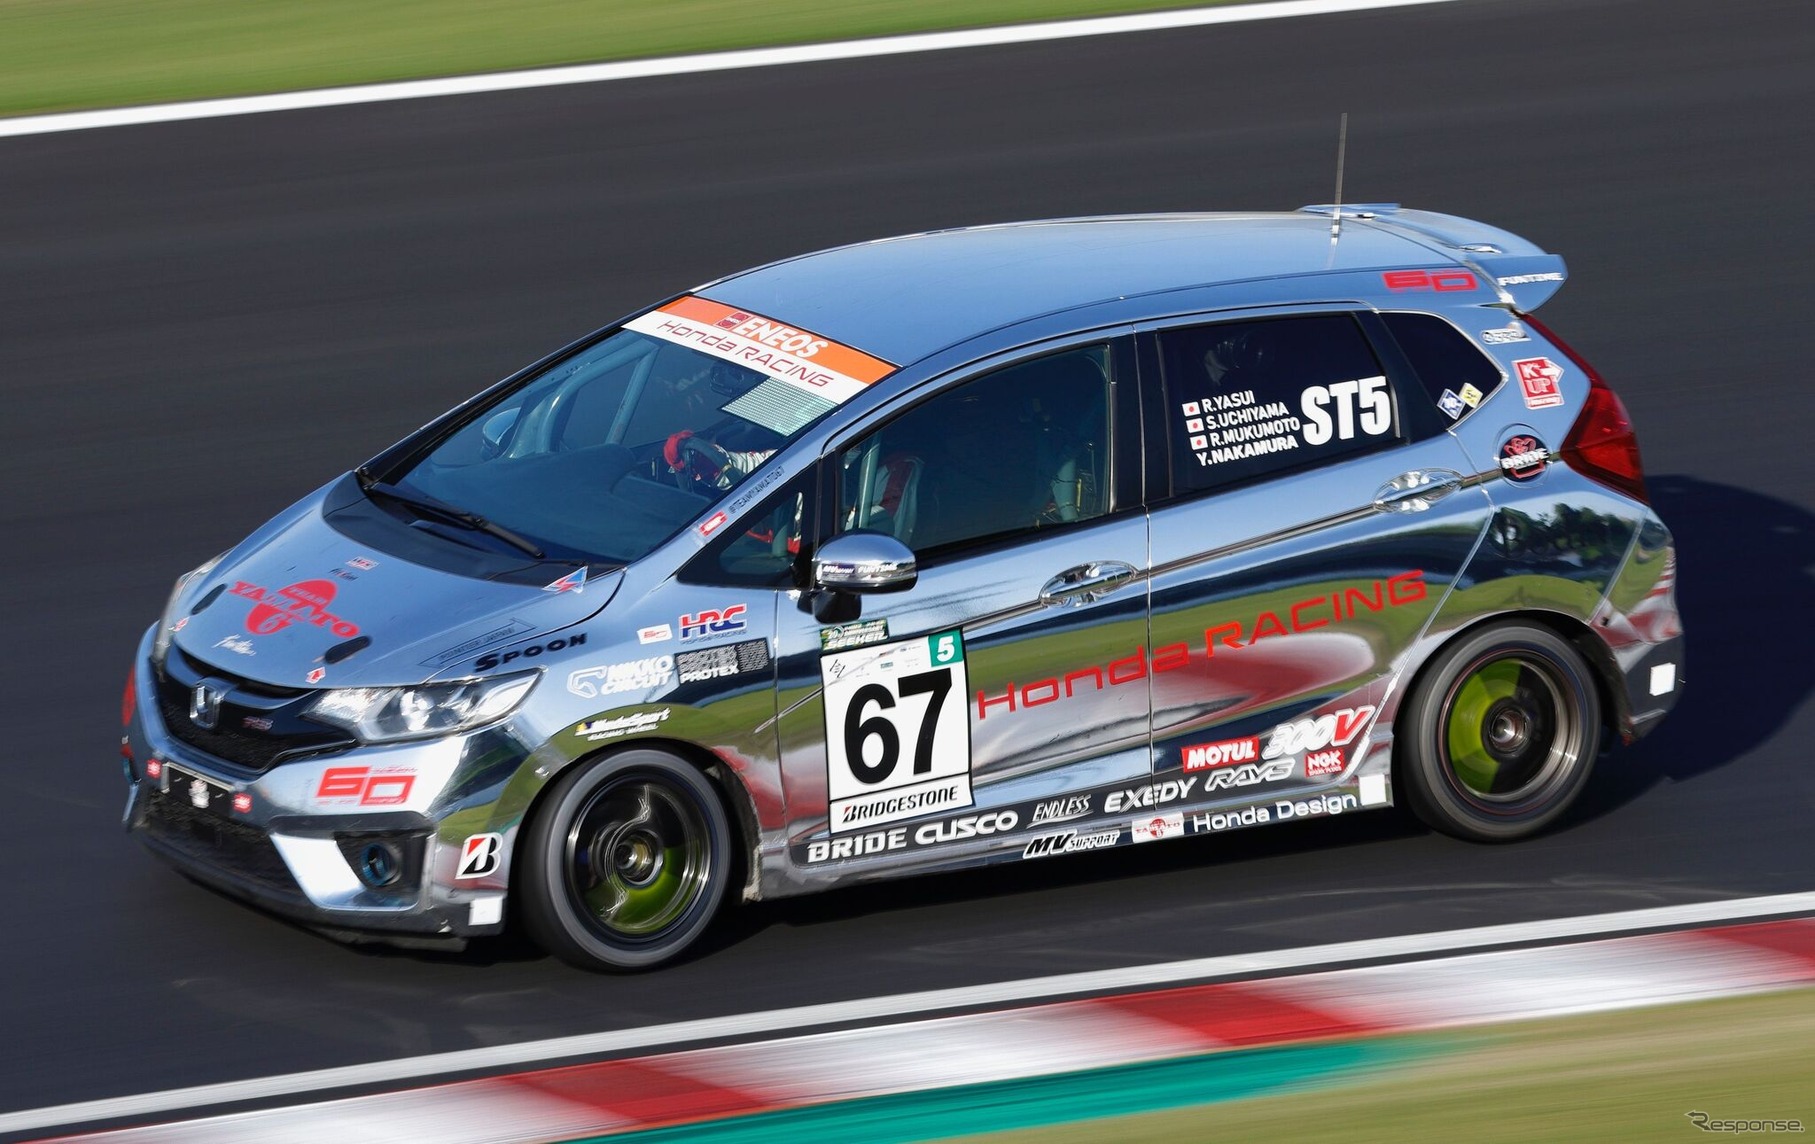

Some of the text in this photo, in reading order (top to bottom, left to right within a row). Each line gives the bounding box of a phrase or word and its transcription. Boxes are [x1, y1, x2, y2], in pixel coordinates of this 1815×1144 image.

[657, 320, 835, 388] Honda RACING
[731, 317, 829, 358] ENEOS
[1201, 389, 1256, 413] R.YASUI
[1206, 401, 1289, 430] S.UCHIYAMA
[1300, 375, 1392, 446] ST5
[1196, 434, 1299, 467] Y.NAKAMURA
[1210, 416, 1301, 447] R.MUKUMOTO
[679, 603, 747, 641] HRC
[473, 632, 588, 673] SPOON
[936, 635, 956, 662] 5
[977, 568, 1427, 720] Honda RACING
[601, 671, 673, 696] CIRCUIT
[606, 655, 675, 681] NIKKO
[679, 664, 740, 684] PROTEX
[844, 667, 953, 785] 67
[1262, 705, 1376, 760] 300V
[1186, 739, 1257, 770] MOTUL
[1307, 750, 1342, 770] NGK
[806, 757, 1296, 863] BRIDE CUSCO ENDLESS EXEDY RAYS
[842, 785, 960, 823] BRIDGESTONE
[1193, 793, 1357, 832] Honda Design
